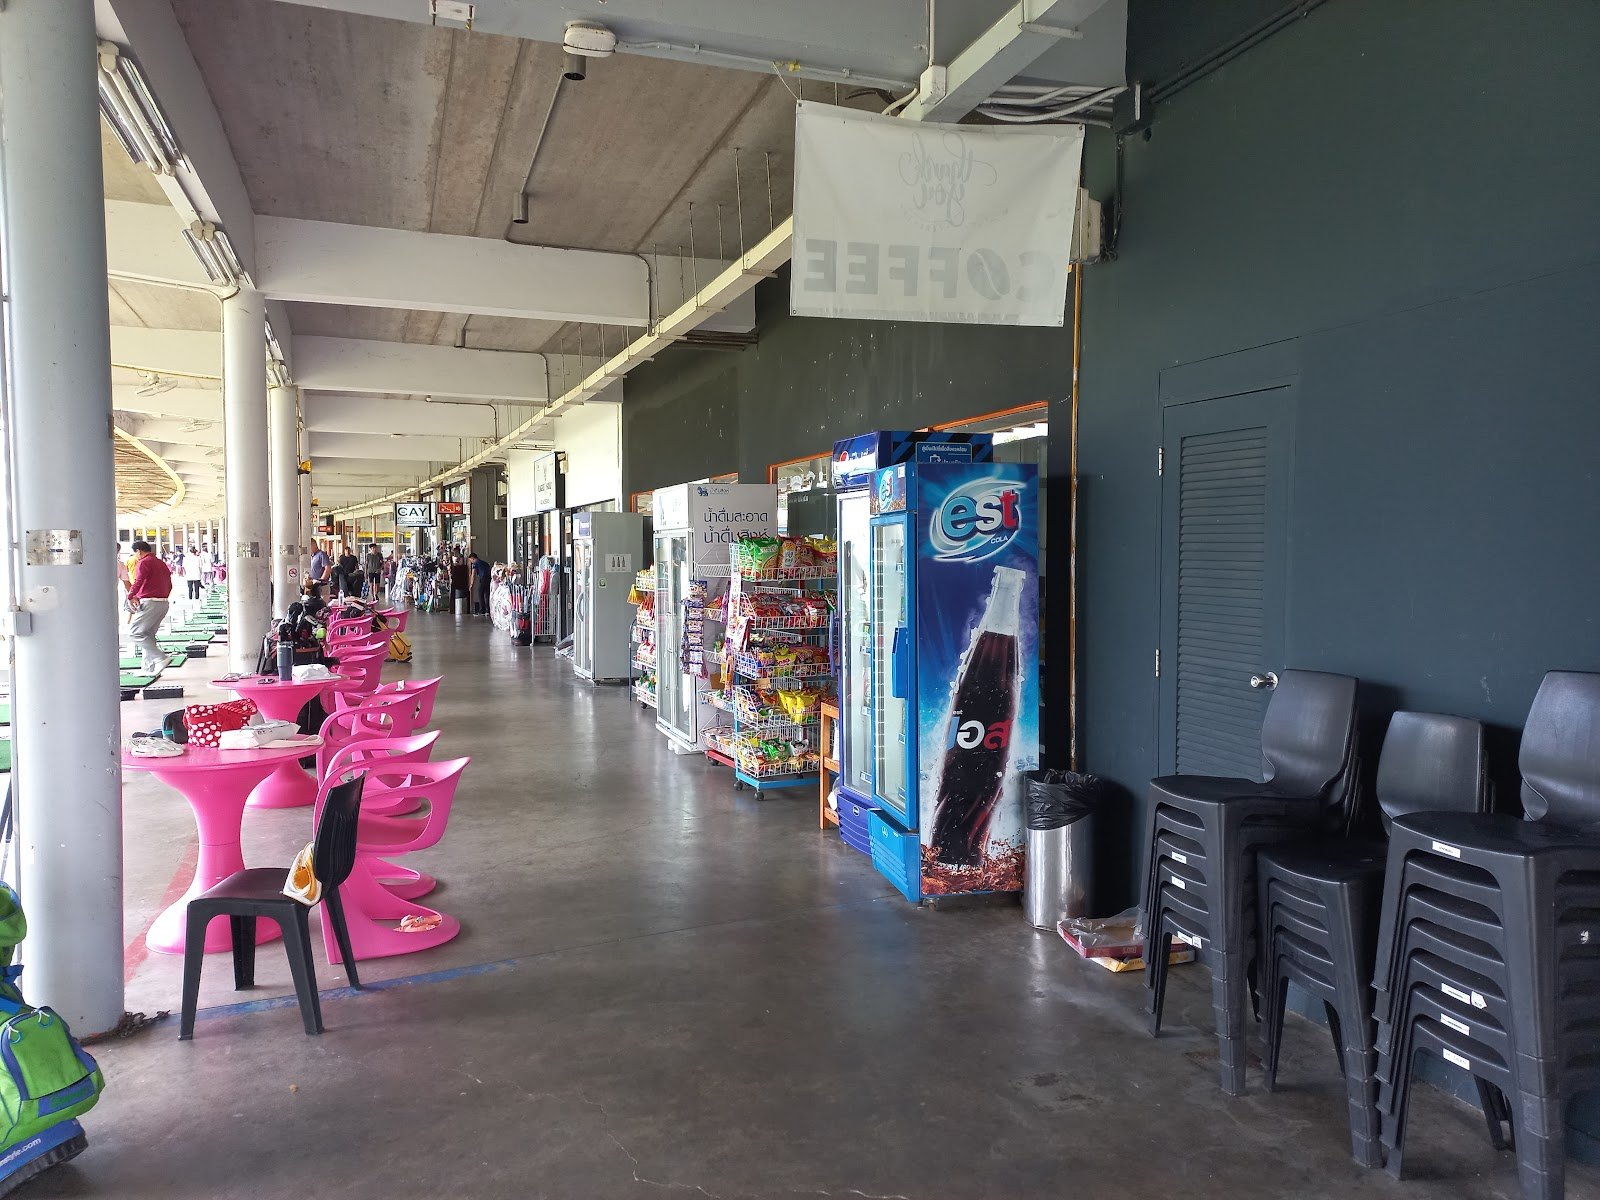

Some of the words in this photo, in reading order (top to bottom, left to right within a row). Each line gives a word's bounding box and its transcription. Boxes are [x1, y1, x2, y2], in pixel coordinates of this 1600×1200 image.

[398, 507, 427, 517] CAY
[704, 507, 768, 523] น้ำดื่มสะอาด
[940, 489, 1020, 541] est
[990, 535, 1009, 544] COLA
